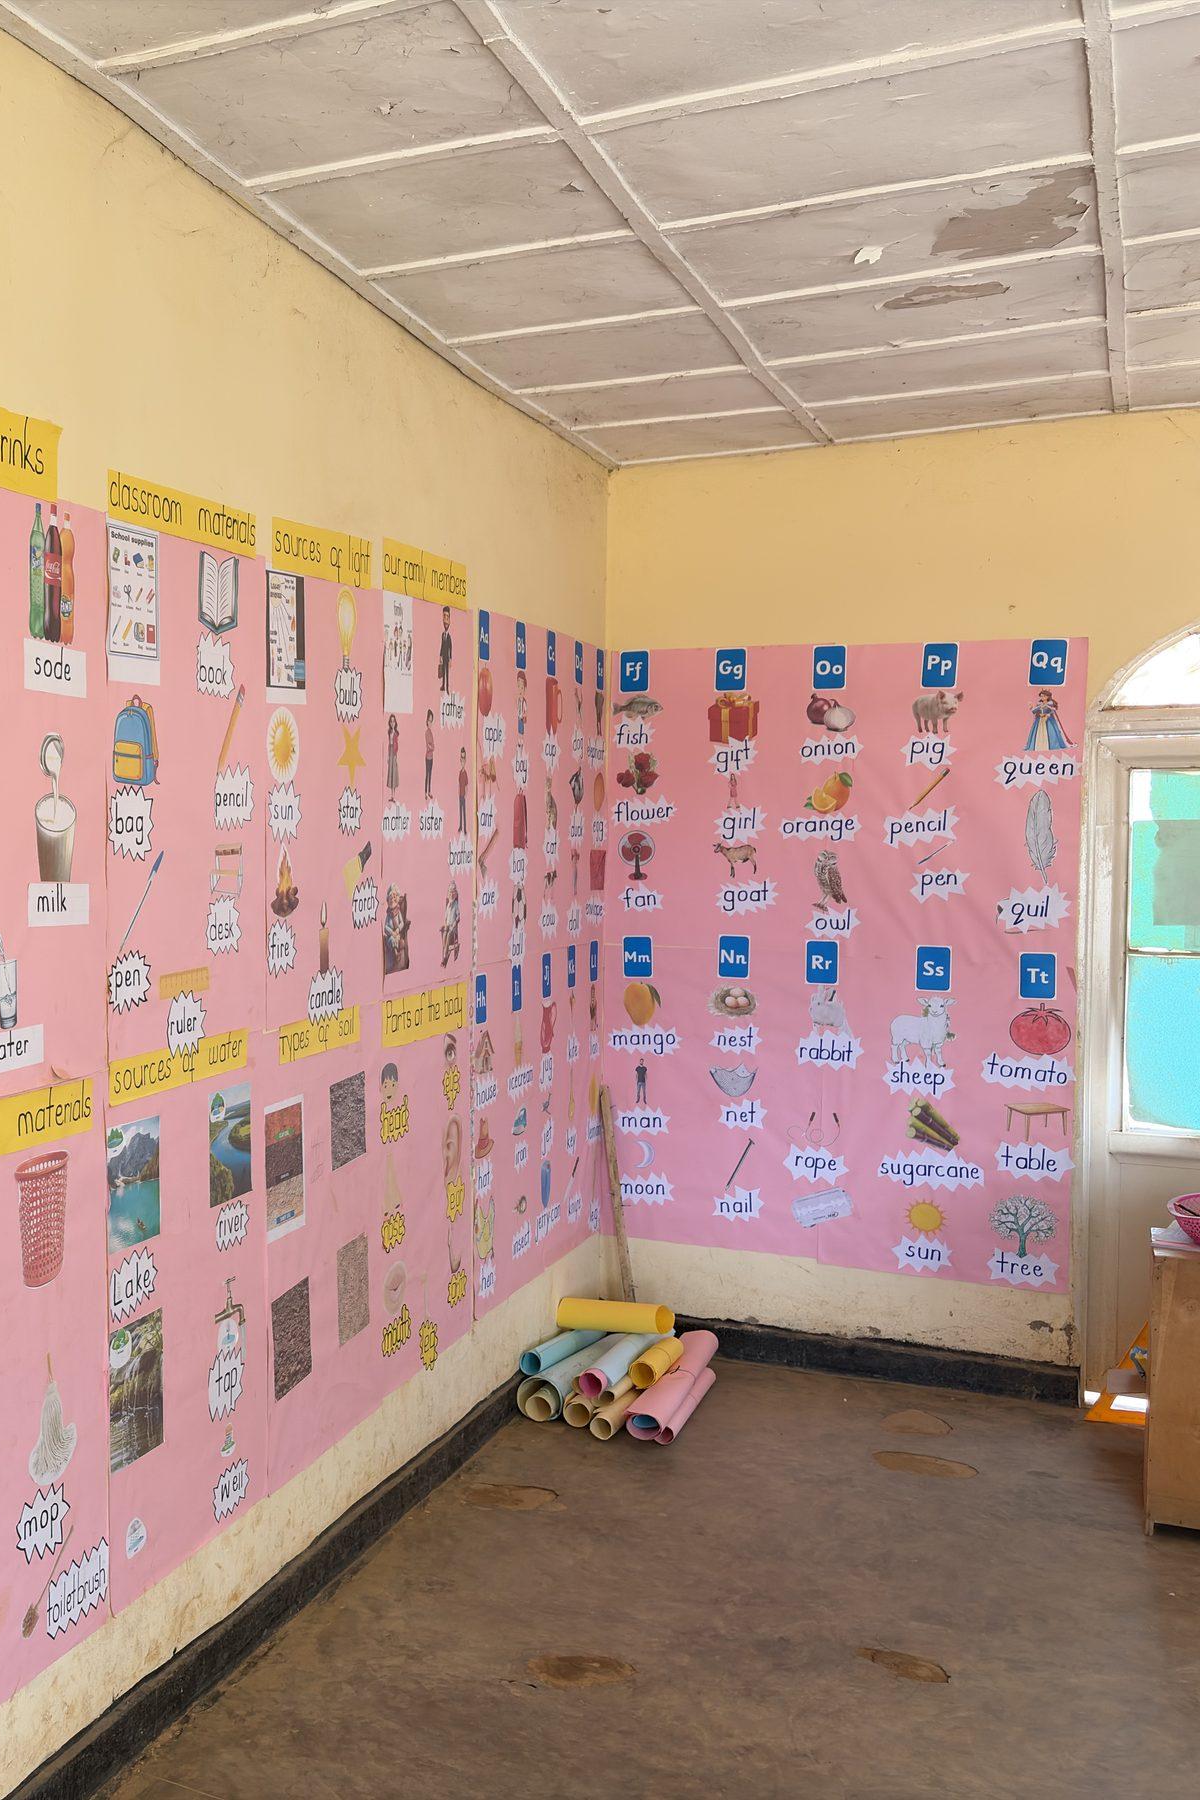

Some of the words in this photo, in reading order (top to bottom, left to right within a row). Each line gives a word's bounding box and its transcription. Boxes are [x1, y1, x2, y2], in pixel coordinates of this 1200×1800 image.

[110, 473, 182, 525] classroom
[198, 505, 256, 546] materials
[111, 531, 130, 542] School
[131, 537, 153, 547] supplies
[275, 530, 321, 563] sources
[330, 547, 343, 583] of
[348, 535, 370, 587] light
[384, 553, 400, 575] our
[431, 560, 466, 597] members
[480, 628, 488, 643] Aa
[34, 647, 71, 681] sode
[198, 651, 227, 685] book
[626, 662, 642, 681] Ff
[719, 660, 742, 679] Gg
[816, 661, 842, 675] Oo
[927, 655, 951, 676] Pp
[1032, 652, 1063, 673] Qq
[339, 676, 357, 706] bulb
[442, 693, 463, 727] father
[485, 719, 502, 752] apple
[616, 724, 648, 745] fish
[545, 743, 556, 766] cup
[717, 740, 750, 773] gift
[801, 740, 855, 758] onion
[911, 737, 944, 764] pig
[515, 757, 528, 783] boy
[1003, 760, 1074, 784] queen
[216, 782, 248, 816] pencil
[273, 802, 294, 820] sun
[340, 794, 359, 819] star
[614, 801, 673, 822] flower
[115, 803, 143, 845] bag
[383, 806, 409, 831] mother
[419, 807, 442, 831] sister
[480, 805, 493, 826] ant
[722, 808, 756, 840] girl
[890, 810, 947, 844] pencil
[783, 818, 855, 841] orange
[449, 840, 473, 865] brother
[512, 851, 524, 881] bag
[724, 881, 768, 911] goat
[921, 872, 958, 895] pen
[37, 884, 67, 913] milk
[482, 890, 495, 906] axe
[623, 888, 656, 908] fan
[1011, 895, 1049, 925] quil
[210, 909, 234, 942] desk
[542, 913, 556, 926] cow
[815, 910, 850, 930] owl
[270, 933, 290, 961] fire
[512, 933, 523, 956] ball
[624, 952, 650, 962] Mm
[720, 950, 746, 965] Nn
[812, 956, 832, 969] Rr
[923, 962, 944, 976] Ss
[115, 967, 140, 1000] pen
[544, 965, 550, 985] Jj
[1027, 968, 1048, 984] Tt
[309, 978, 341, 1007] candle
[476, 991, 486, 1008] Hh
[170, 1007, 197, 1034] ruler
[386, 997, 412, 1034] Parts
[415, 992, 424, 1027] of
[427, 988, 441, 1022] the
[443, 984, 463, 1028] body
[318, 1024, 329, 1050] of
[339, 1006, 354, 1037] soil
[718, 1027, 752, 1047] nest
[612, 1033, 676, 1054] mango
[800, 1041, 852, 1062] rabbit
[114, 1057, 172, 1094] sources
[183, 1051, 196, 1082] of
[208, 1031, 243, 1066] water
[540, 1058, 553, 1084] jug
[987, 1053, 1068, 1085] tomato
[891, 1062, 945, 1095] sheep
[476, 1080, 496, 1106] house
[17, 1080, 91, 1136] materials
[726, 1102, 756, 1122] net
[622, 1114, 662, 1128] man
[795, 1155, 837, 1178] rope
[1001, 1146, 1058, 1172] table
[478, 1163, 491, 1190] hat
[880, 1161, 980, 1185] sugarcane
[620, 1181, 665, 1196] moon
[720, 1192, 752, 1213] nail
[218, 1211, 245, 1237] river
[905, 1245, 942, 1261] sun
[996, 1253, 1043, 1278] tree
[112, 1269, 152, 1305] Lake
[481, 1267, 494, 1291] hen
[216, 1357, 238, 1408] tap
[220, 1470, 244, 1501] well
[24, 1503, 58, 1539] mop
